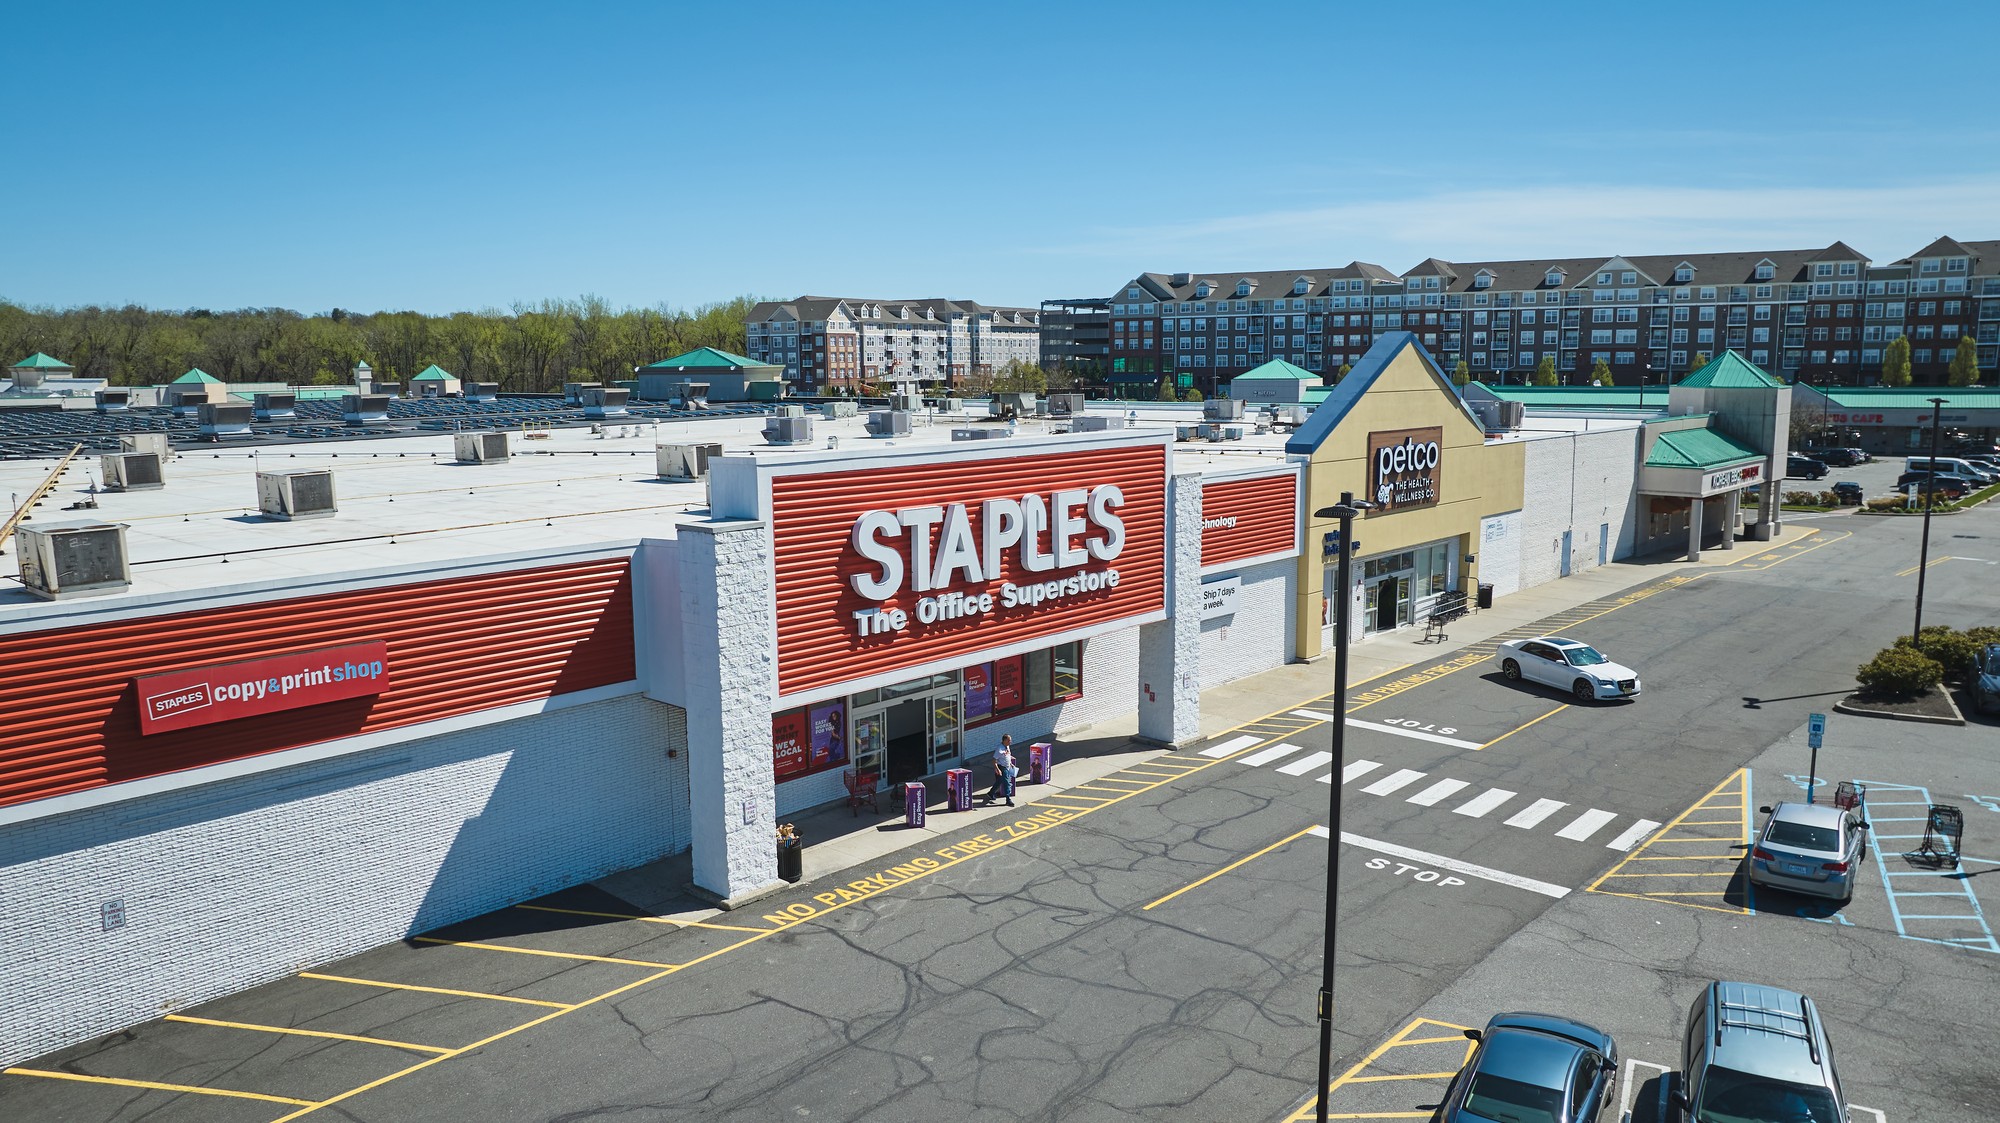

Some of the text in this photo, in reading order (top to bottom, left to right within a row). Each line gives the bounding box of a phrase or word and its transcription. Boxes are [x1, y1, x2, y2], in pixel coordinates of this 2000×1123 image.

[1379, 437, 1439, 486] petco
[1395, 481, 1407, 491] THE
[1408, 478, 1430, 488] HEALTH
[1395, 490, 1425, 503] WELLNESS
[851, 484, 1126, 601] STAPLES
[1203, 586, 1235, 601] Ship 7 days
[852, 569, 1120, 637] The Office Superstore
[1203, 603, 1208, 611] a
[1352, 691, 1379, 703] NO
[1373, 673, 1429, 696] PARKING
[1449, 653, 1489, 669] ZONE
[156, 691, 204, 712] STAPLES
[1384, 718, 1458, 735] STOP
[775, 741, 789, 751] WE
[775, 745, 803, 759] LOCAL
[762, 809, 1074, 926] NO PARKING FIRE ZONE
[1365, 858, 1466, 887] STOP
[107, 913, 121, 921] FIRE
[107, 919, 123, 927] LANE
